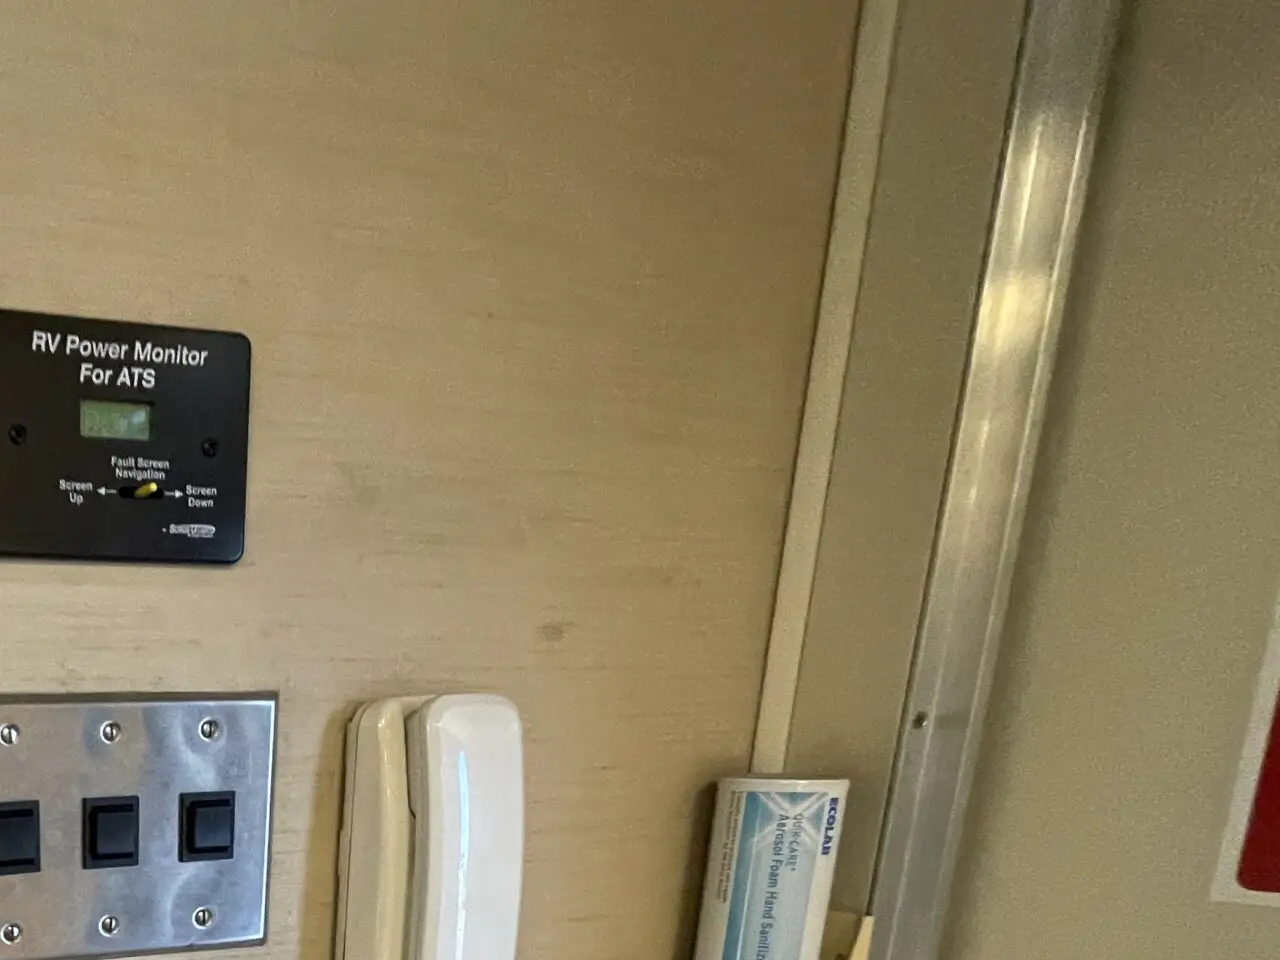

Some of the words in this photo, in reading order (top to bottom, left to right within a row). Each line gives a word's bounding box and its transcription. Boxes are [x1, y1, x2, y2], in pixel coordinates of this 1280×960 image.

[32, 330, 61, 354] RV
[66, 335, 129, 360] Power
[133, 341, 208, 367] Monitor
[79, 364, 113, 386] For
[116, 368, 156, 389] ATS
[111, 456, 135, 468] Fault
[137, 457, 169, 470] Screen
[115, 468, 165, 481] Navigation
[59, 479, 93, 492] Screen
[185, 485, 217, 497] Screen
[69, 493, 84, 507] Up
[188, 498, 214, 508] Down
[772, 813, 790, 856] Aerosol
[821, 797, 839, 856] ECOLAB
[766, 859, 781, 888] Foam
[762, 890, 777, 920] Hand
